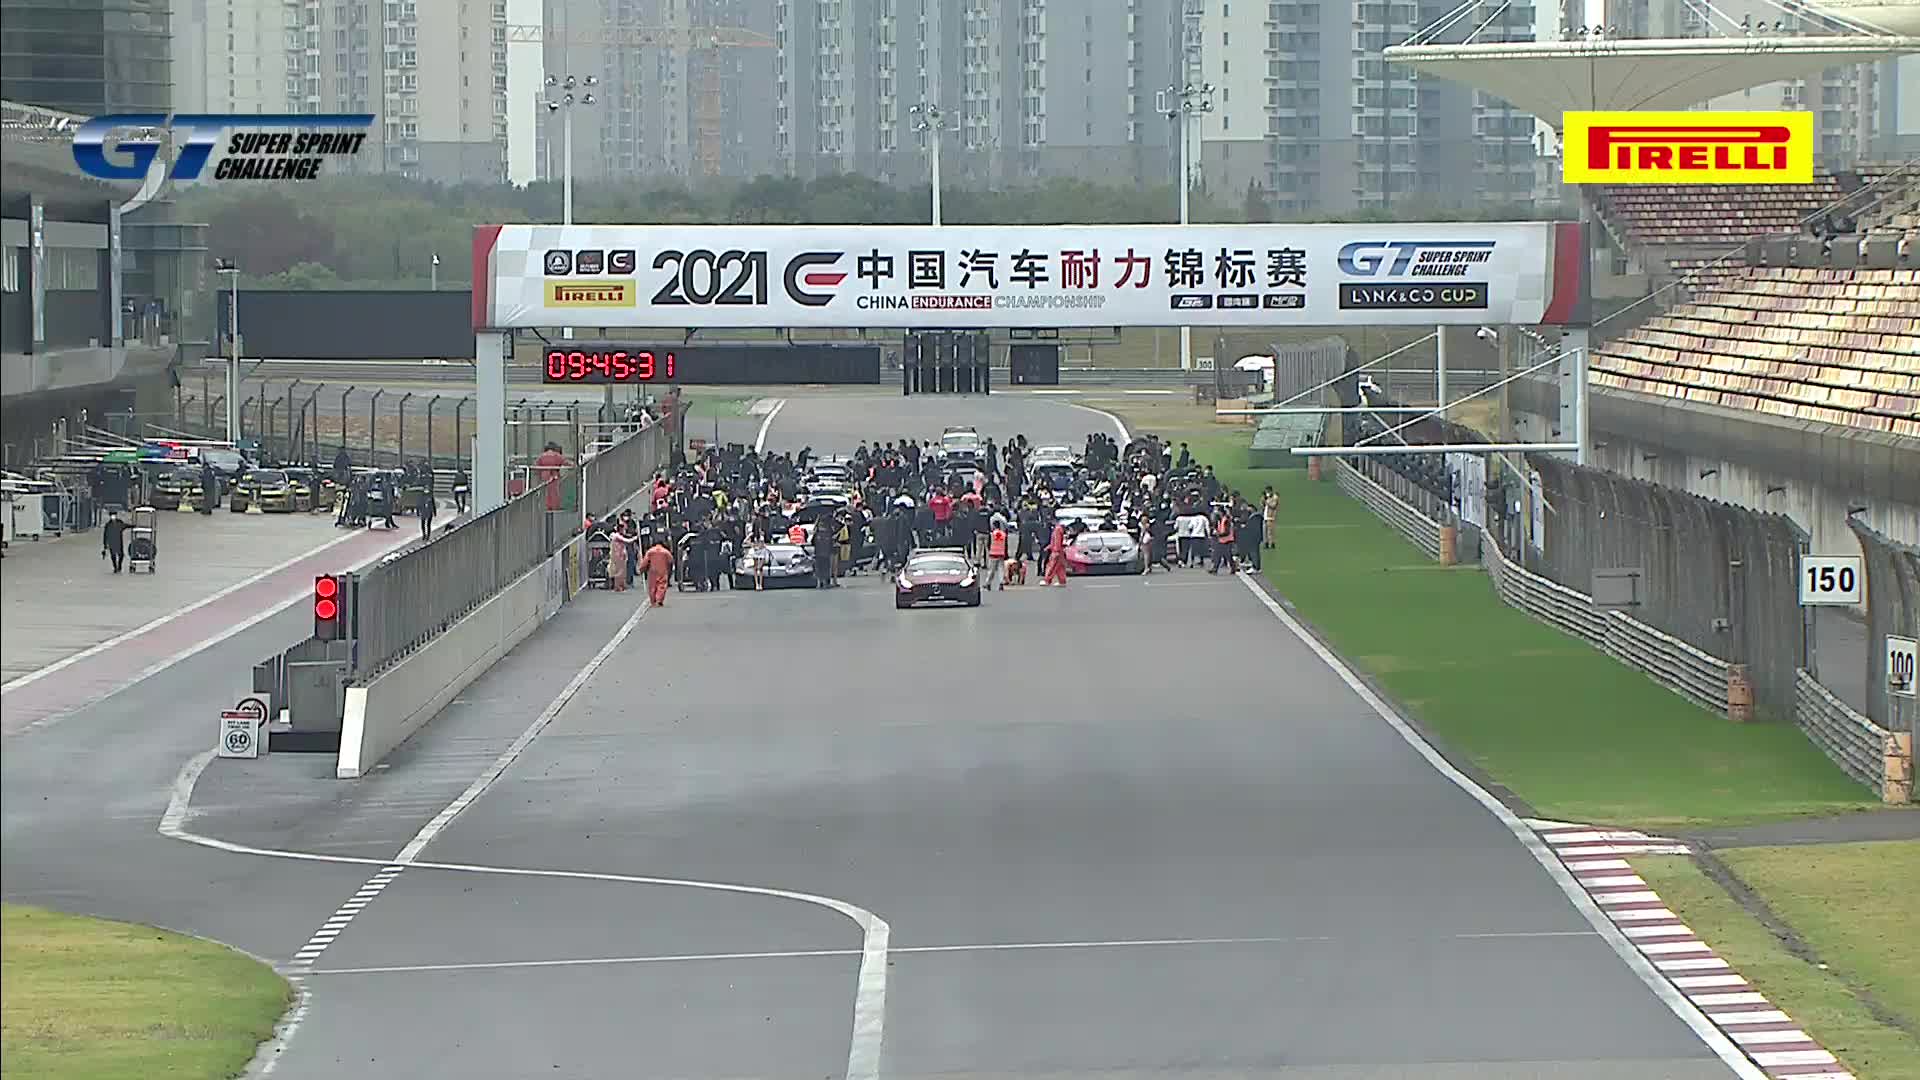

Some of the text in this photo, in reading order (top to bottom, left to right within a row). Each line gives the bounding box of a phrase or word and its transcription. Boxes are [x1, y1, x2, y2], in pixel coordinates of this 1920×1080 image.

[1418, 250, 1493, 263] SUPER SPRINT
[857, 248, 1307, 289] 中国汽车耐力锦标赛
[1411, 264, 1469, 276] CHALLENGE
[651, 249, 768, 305] 2021
[555, 285, 624, 301] PIRELLI
[1441, 289, 1477, 303] CUP
[857, 295, 1106, 309] CHINA ENDURANCE CHAMPIONSHIP
[548, 352, 675, 378] 09:45:31
[1807, 566, 1854, 592] 150
[1890, 650, 1914, 682] 100
[229, 734, 247, 745] 60
